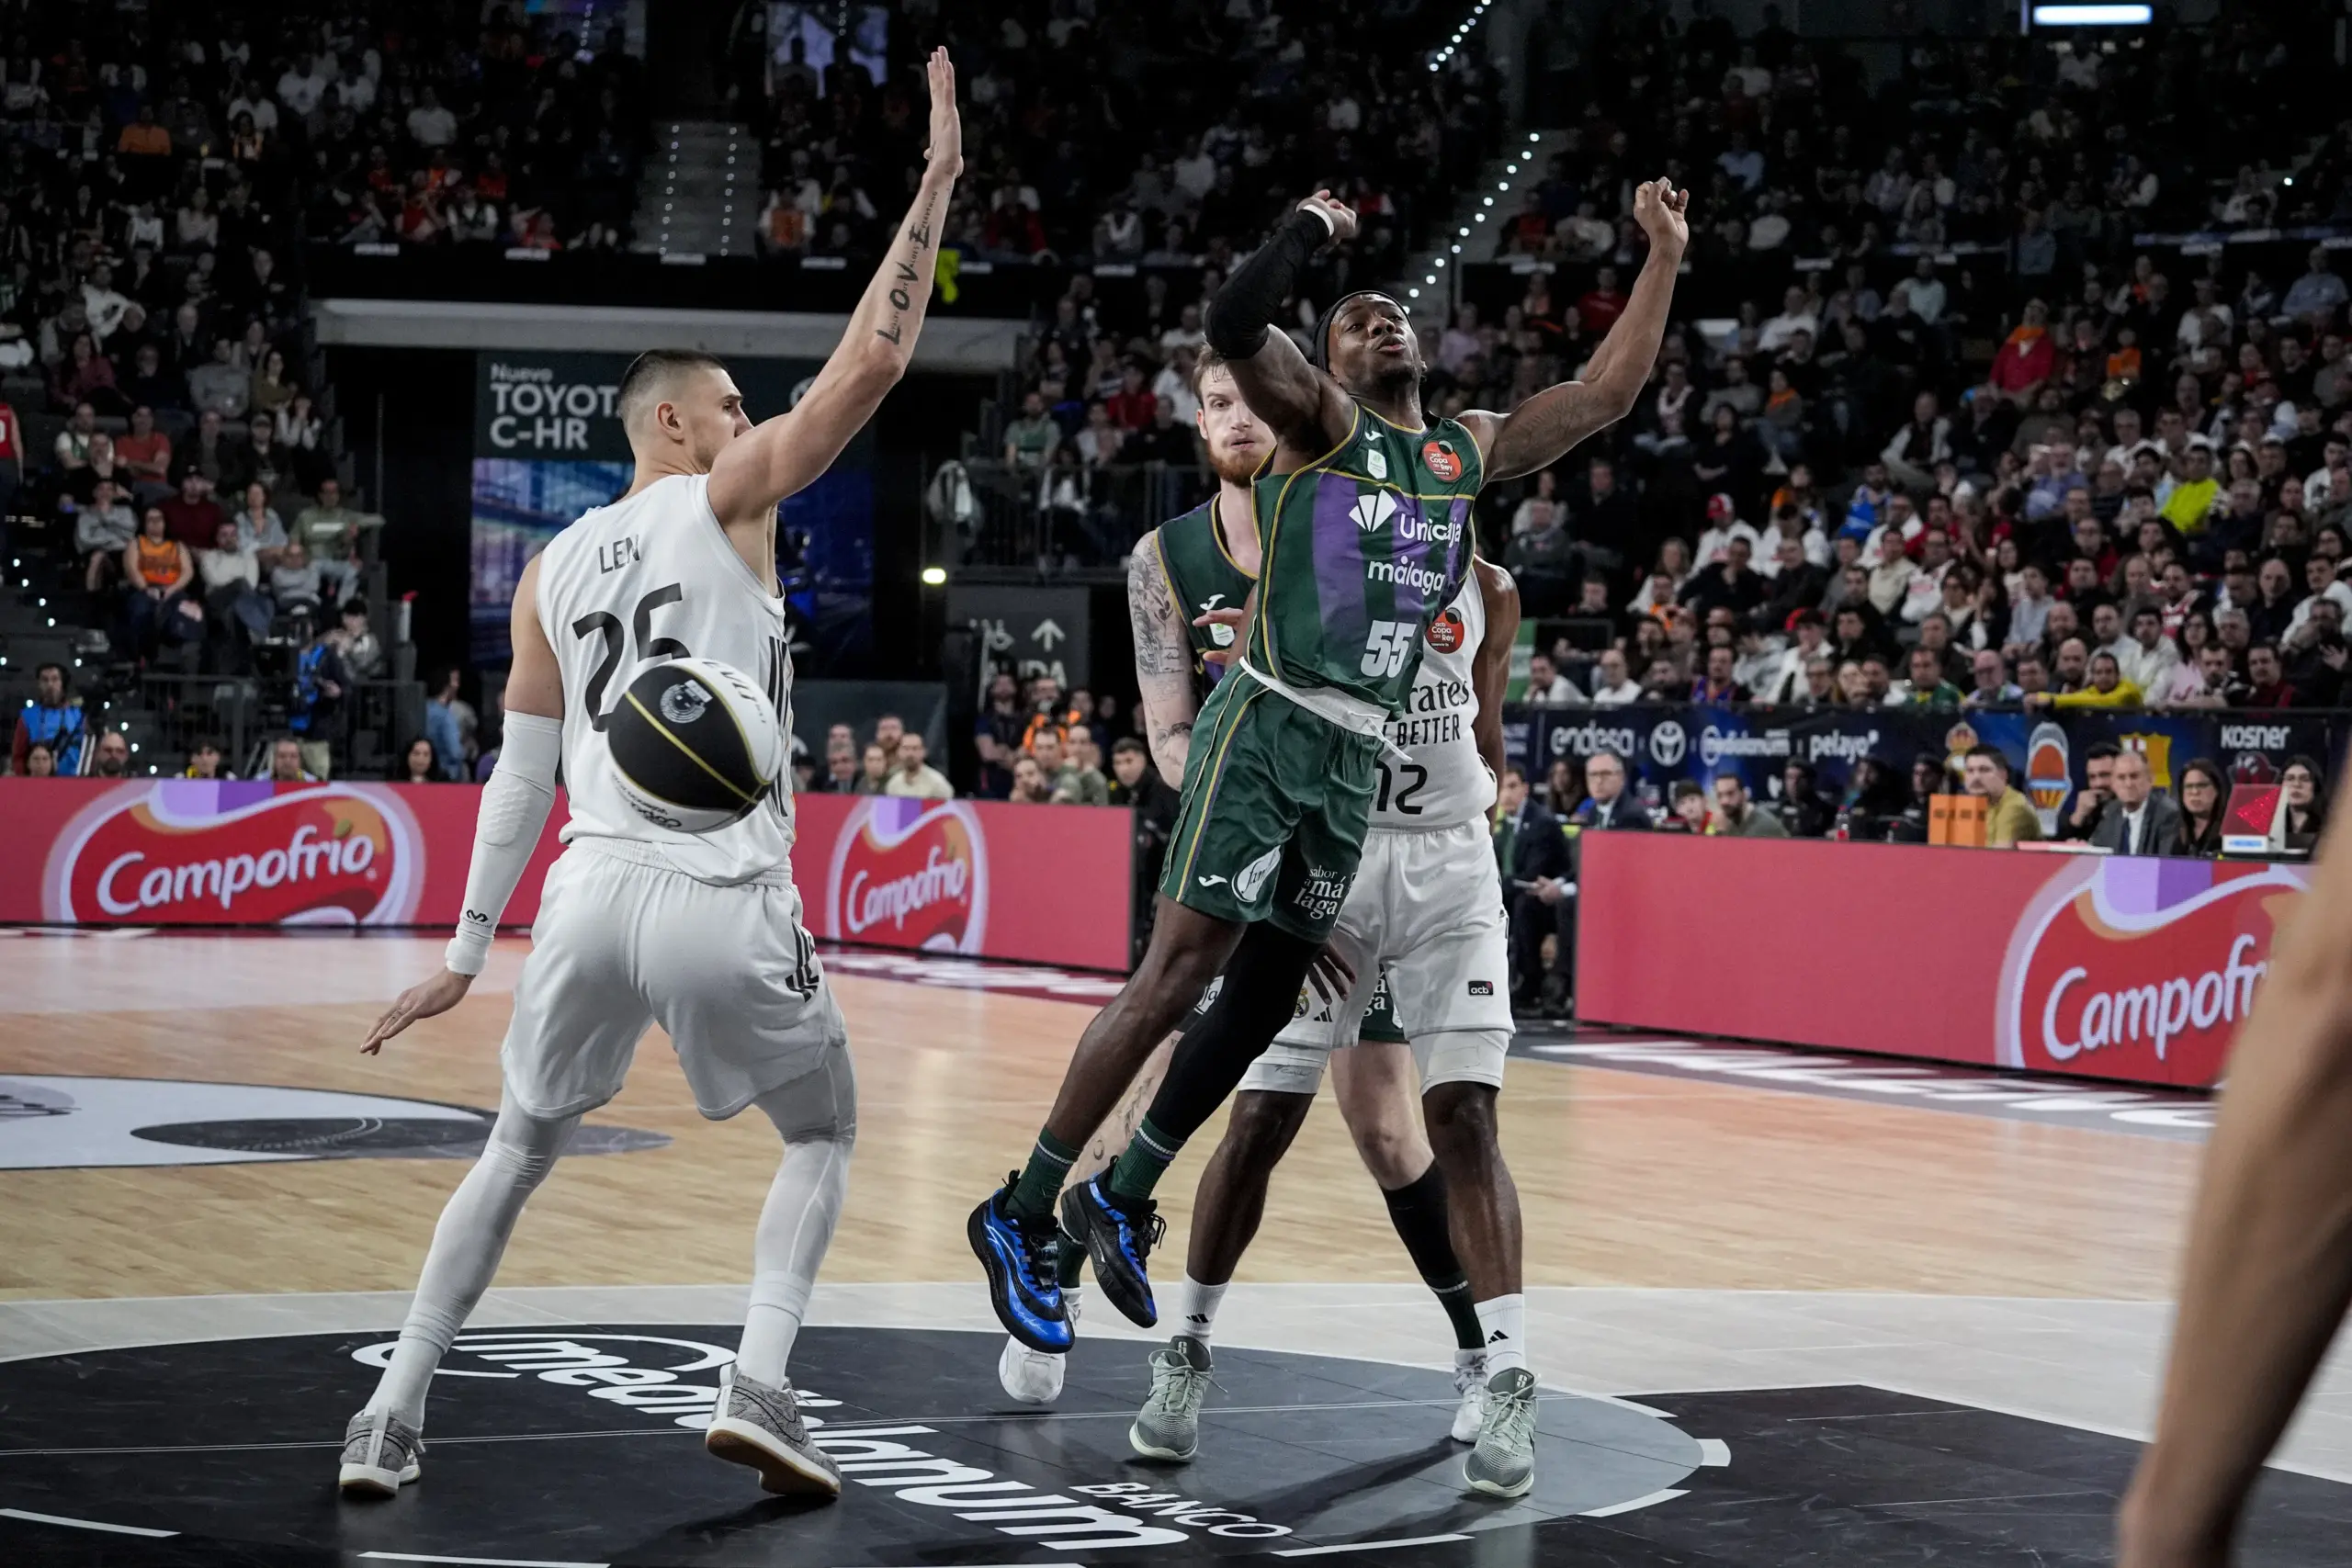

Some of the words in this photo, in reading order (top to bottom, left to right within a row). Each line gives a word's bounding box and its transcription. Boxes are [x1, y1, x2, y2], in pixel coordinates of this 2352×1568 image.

[491, 363, 553, 384] Nuevo
[491, 384, 620, 417] TOYOT
[490, 416, 589, 451] C-HR
[1399, 513, 1462, 544] Unicaja
[599, 534, 641, 575] LEN
[1368, 555, 1446, 595] málaga
[1431, 626, 1452, 636] Copa
[1442, 634, 1455, 643] Rey
[1361, 620, 1418, 679] 55
[1405, 679, 1469, 714] rates
[1396, 714, 1461, 747] BETTER
[1309, 864, 1338, 879] sabor
[1470, 986, 1489, 995] acb
[2041, 933, 2267, 1062] Campofr
[1068, 1480, 1294, 1539] BANCO
